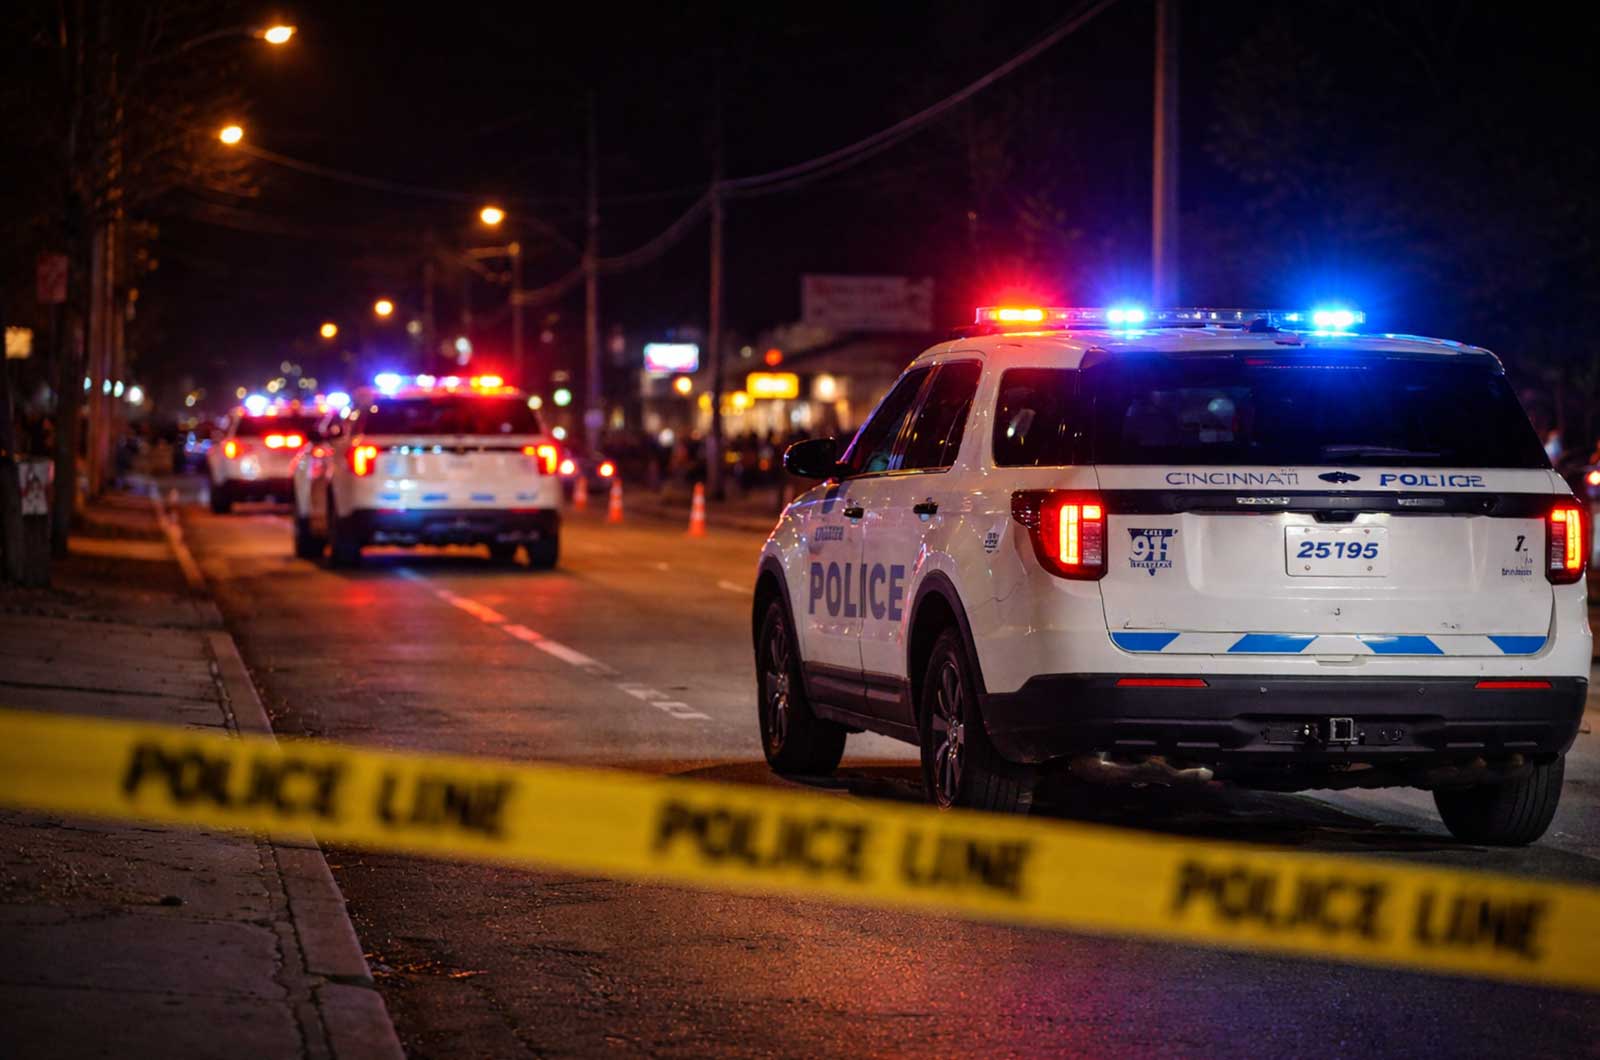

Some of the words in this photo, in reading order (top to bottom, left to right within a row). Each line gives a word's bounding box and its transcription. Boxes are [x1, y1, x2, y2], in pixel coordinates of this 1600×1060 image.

[1165, 472, 1299, 485] CINCINNATI
[1380, 473, 1486, 487] POLICE
[1296, 541, 1379, 559] 25195
[808, 562, 905, 621] POLICE
[121, 739, 346, 824] POLICE
[649, 800, 871, 883] POLICE
[1172, 858, 1390, 941] POLICE
